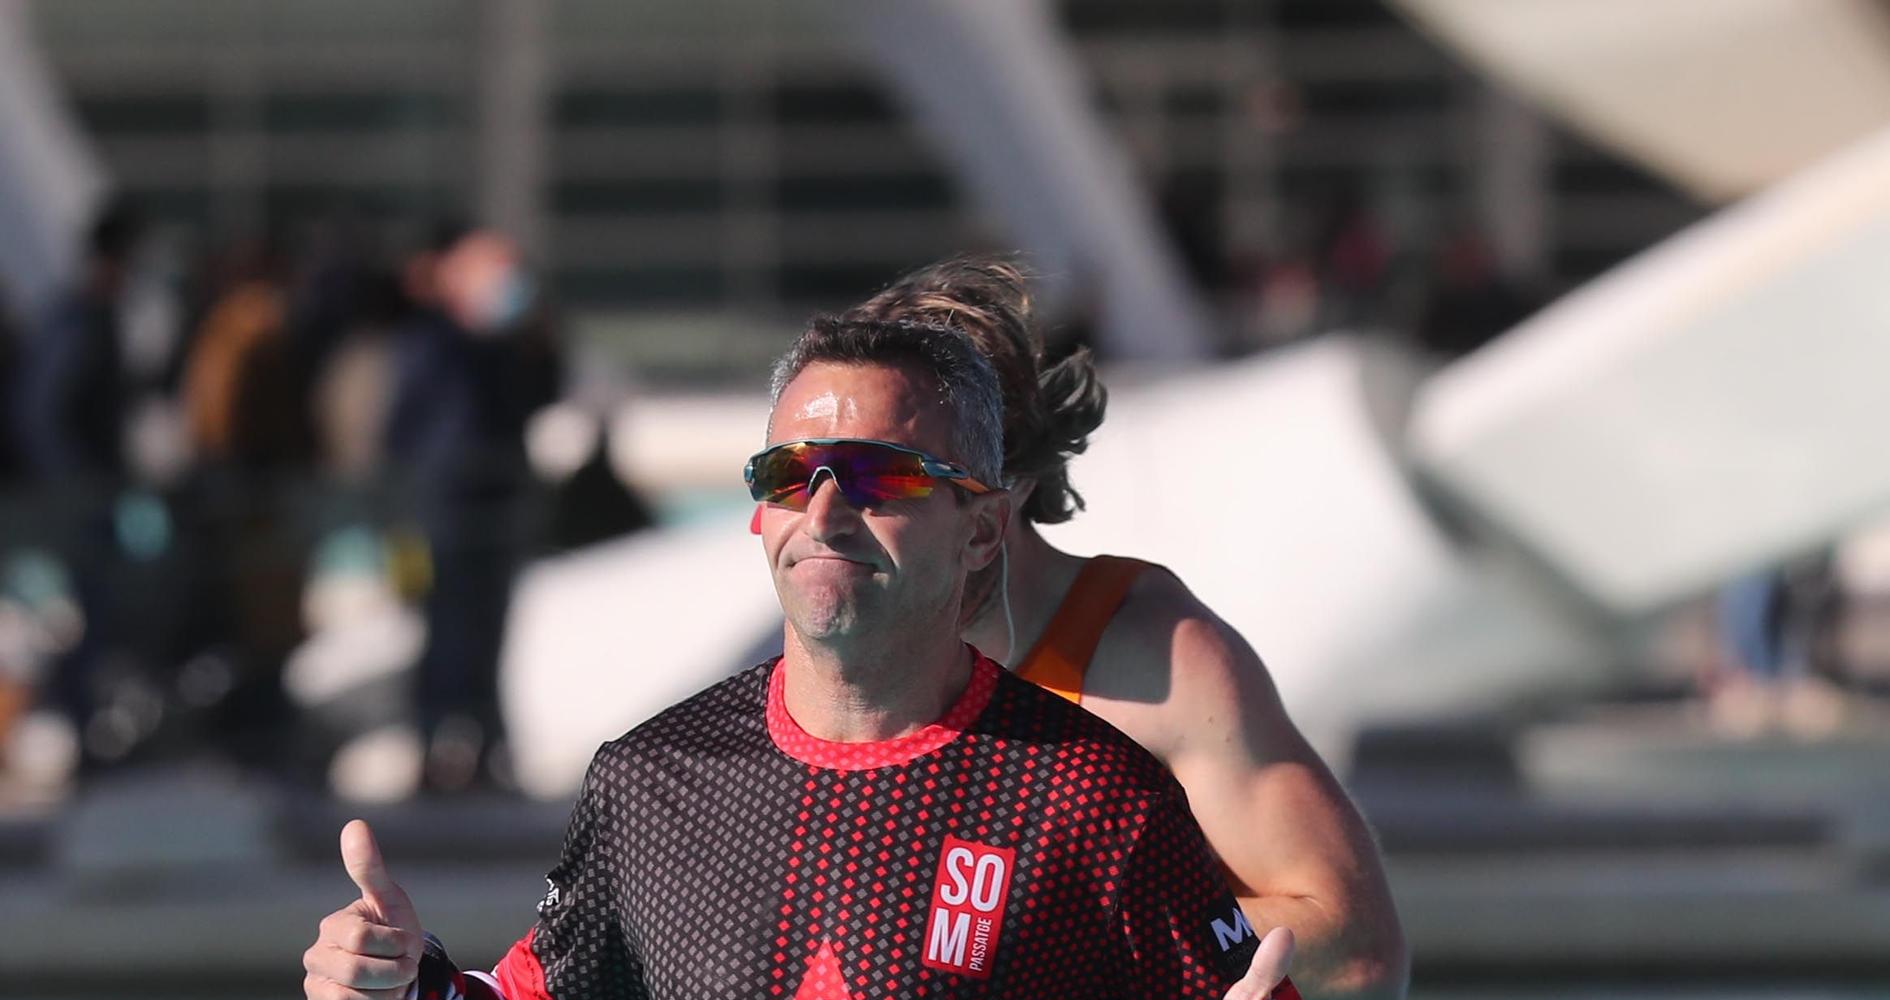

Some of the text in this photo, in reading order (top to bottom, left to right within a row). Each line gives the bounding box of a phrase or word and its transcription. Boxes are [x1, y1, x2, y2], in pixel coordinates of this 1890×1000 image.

[940, 846, 1005, 913] SO
[928, 907, 972, 967] M
[969, 917, 993, 972] PASSATGE
